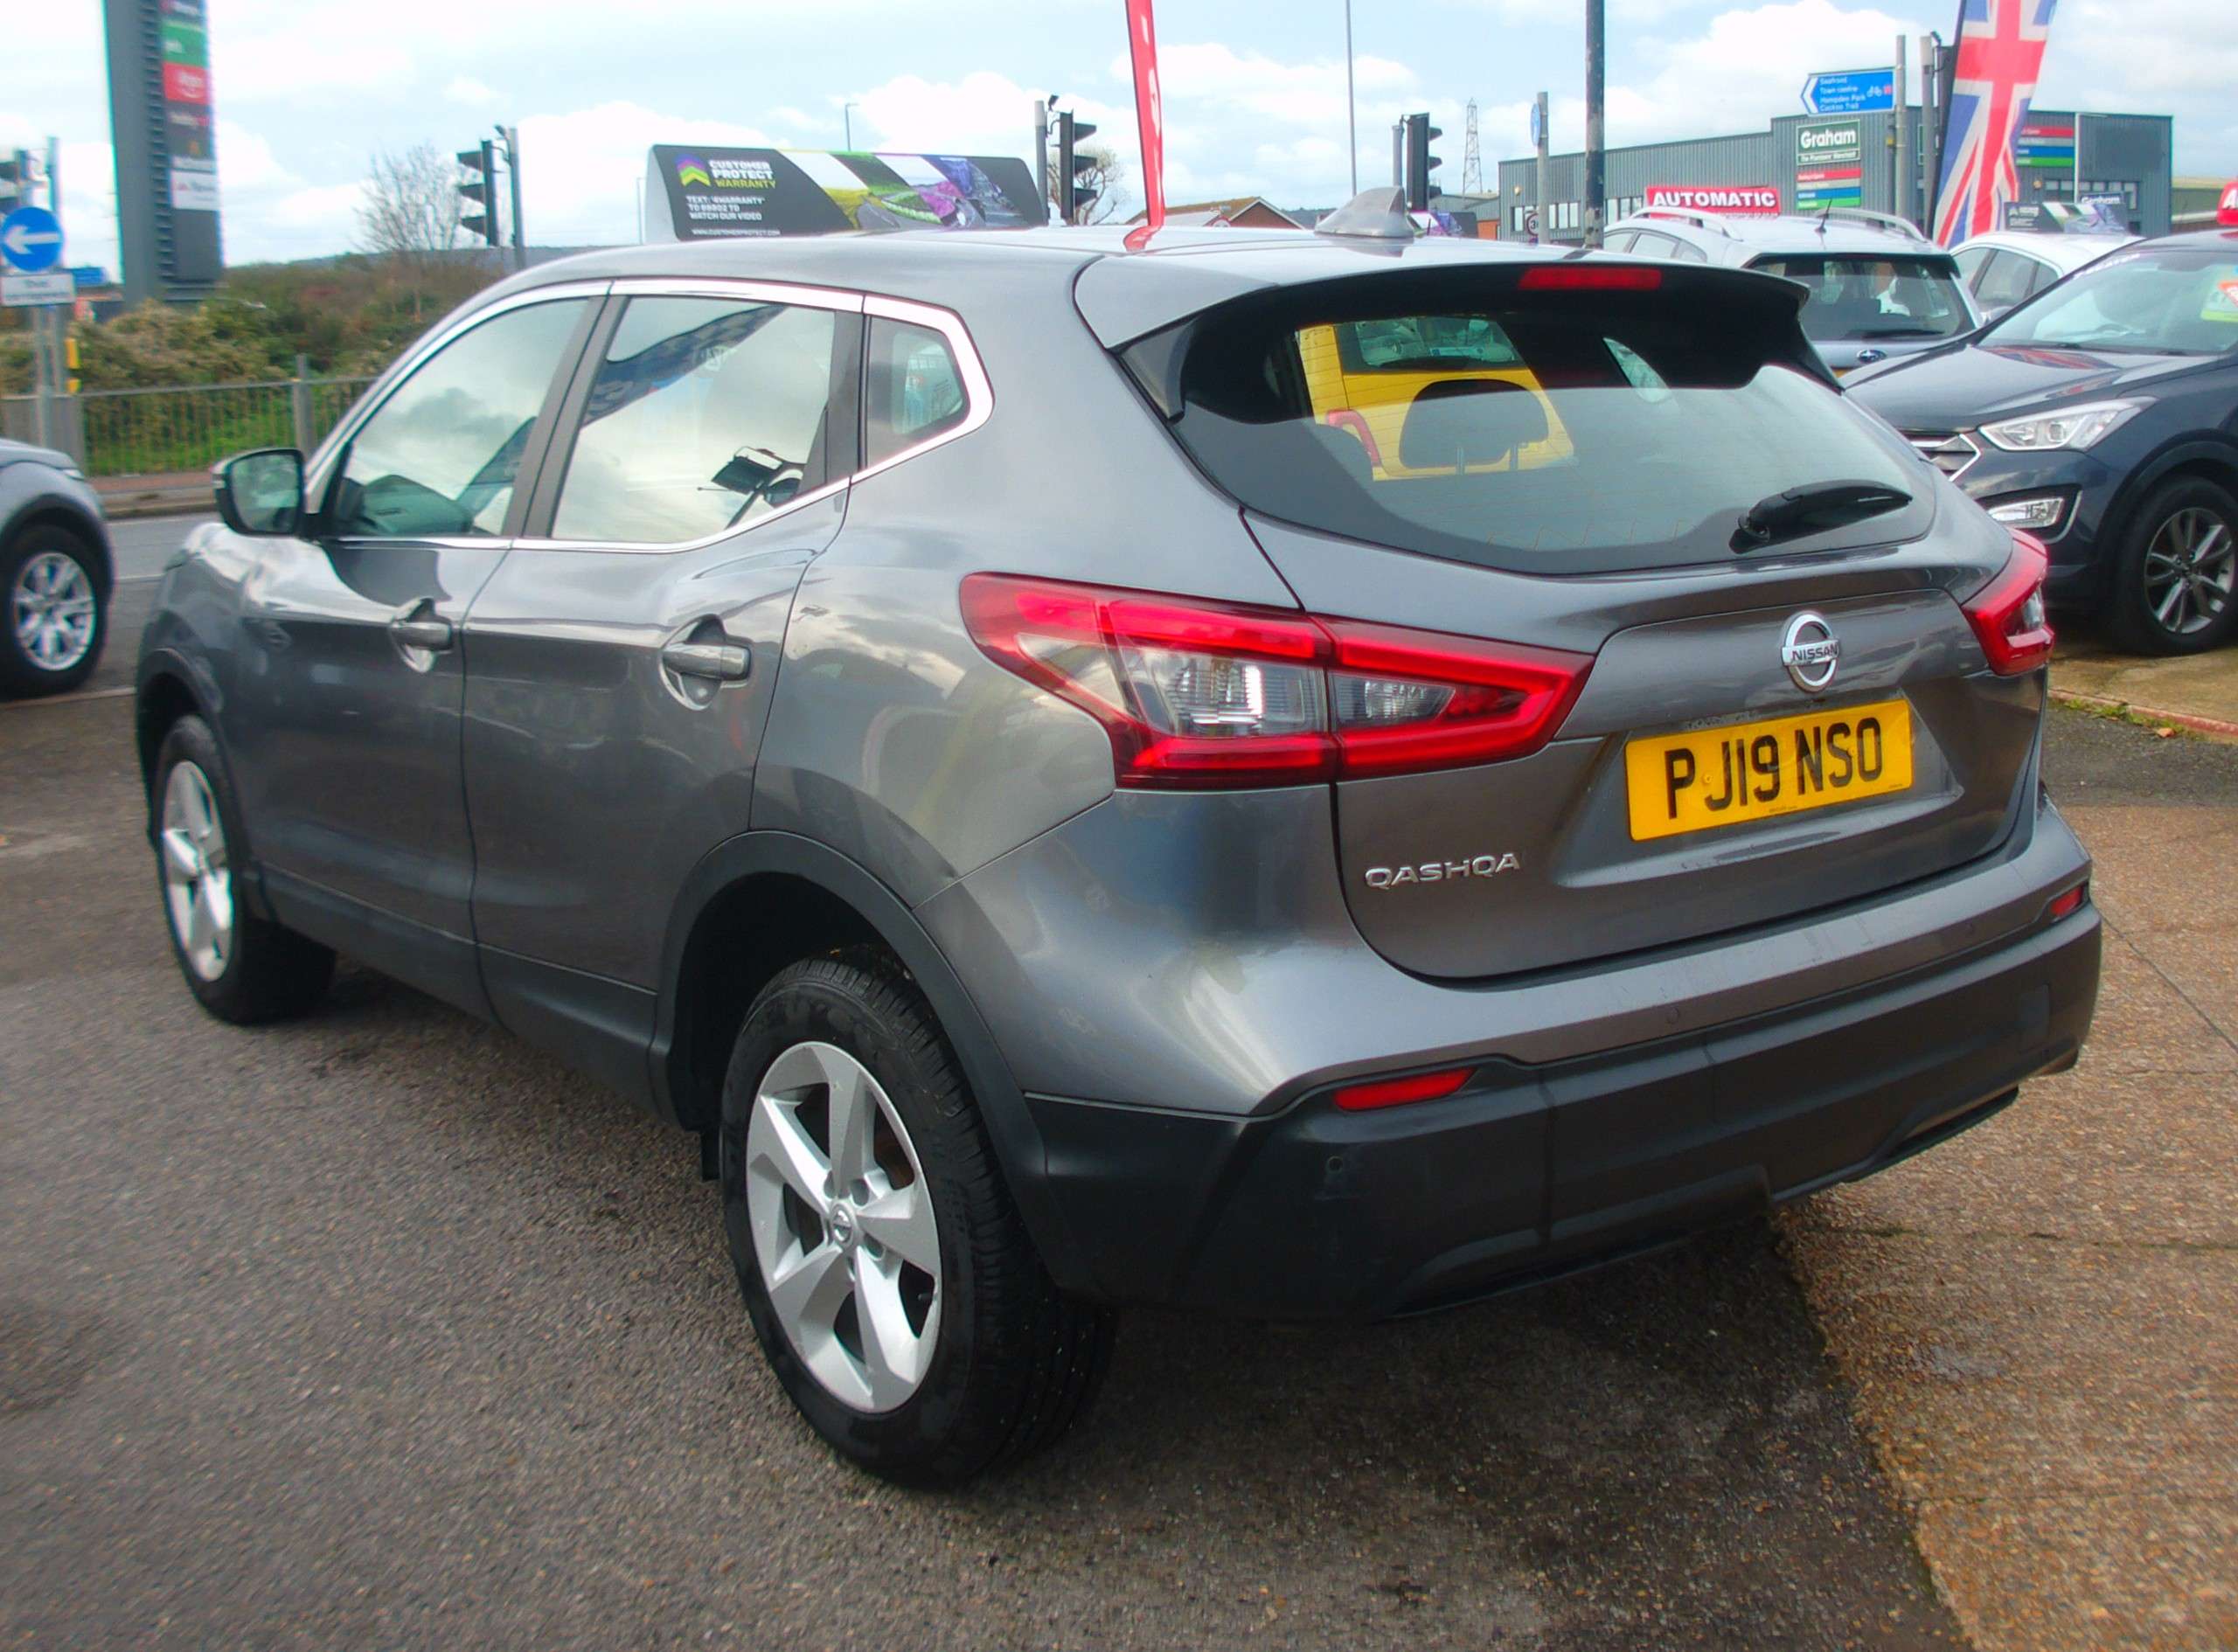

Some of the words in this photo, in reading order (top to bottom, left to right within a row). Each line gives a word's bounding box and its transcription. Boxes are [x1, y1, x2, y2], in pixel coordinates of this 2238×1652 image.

[1800, 128, 1857, 149] Graham
[708, 159, 771, 170] CUSTOMER
[711, 169, 774, 180] PROTECT
[715, 179, 776, 189] WARRANTY
[1652, 191, 1776, 207] AUTOMATIC
[689, 212, 719, 220] WATCH
[737, 212, 762, 221] VIDEO
[1791, 642, 1838, 662] NISSAN
[1664, 734, 1781, 820] PJ19
[1794, 717, 1883, 795] NSO
[1365, 852, 1521, 890] QASHQA
